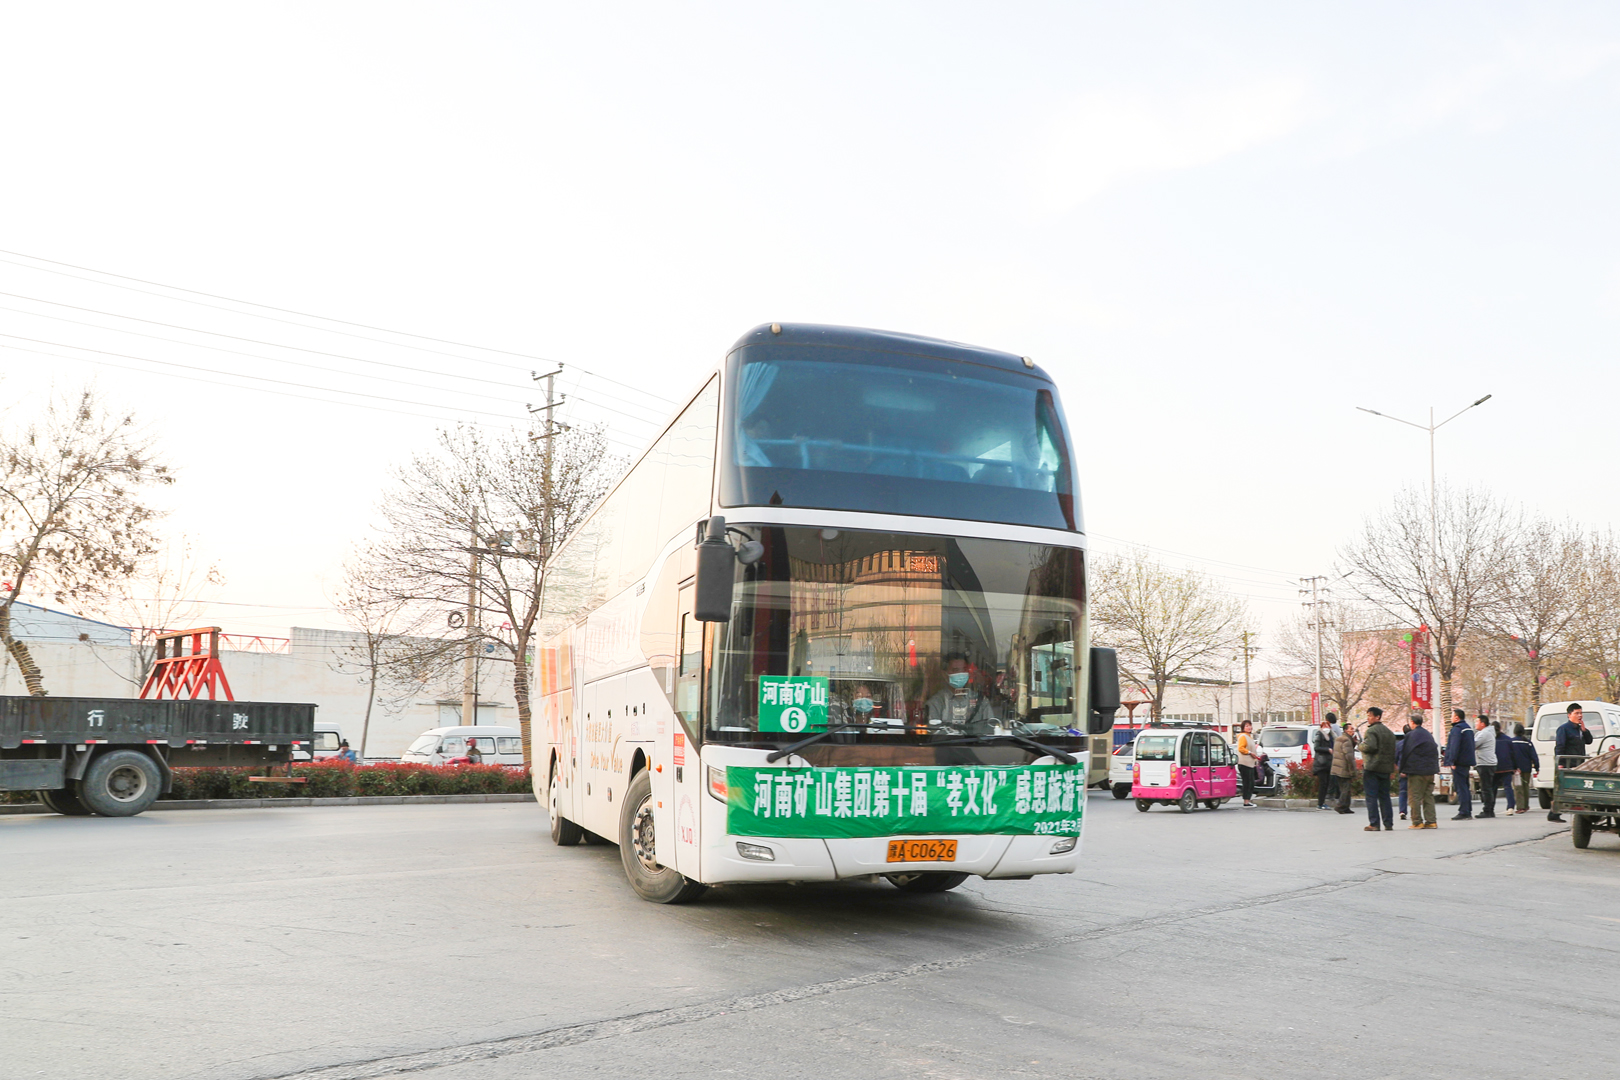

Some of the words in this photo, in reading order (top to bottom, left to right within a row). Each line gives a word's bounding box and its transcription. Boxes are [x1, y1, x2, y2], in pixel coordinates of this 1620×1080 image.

[762, 681, 825, 705] 河南矿山
[87, 709, 104, 727] 行
[232, 713, 249, 729] 驶
[788, 710, 799, 730] 6
